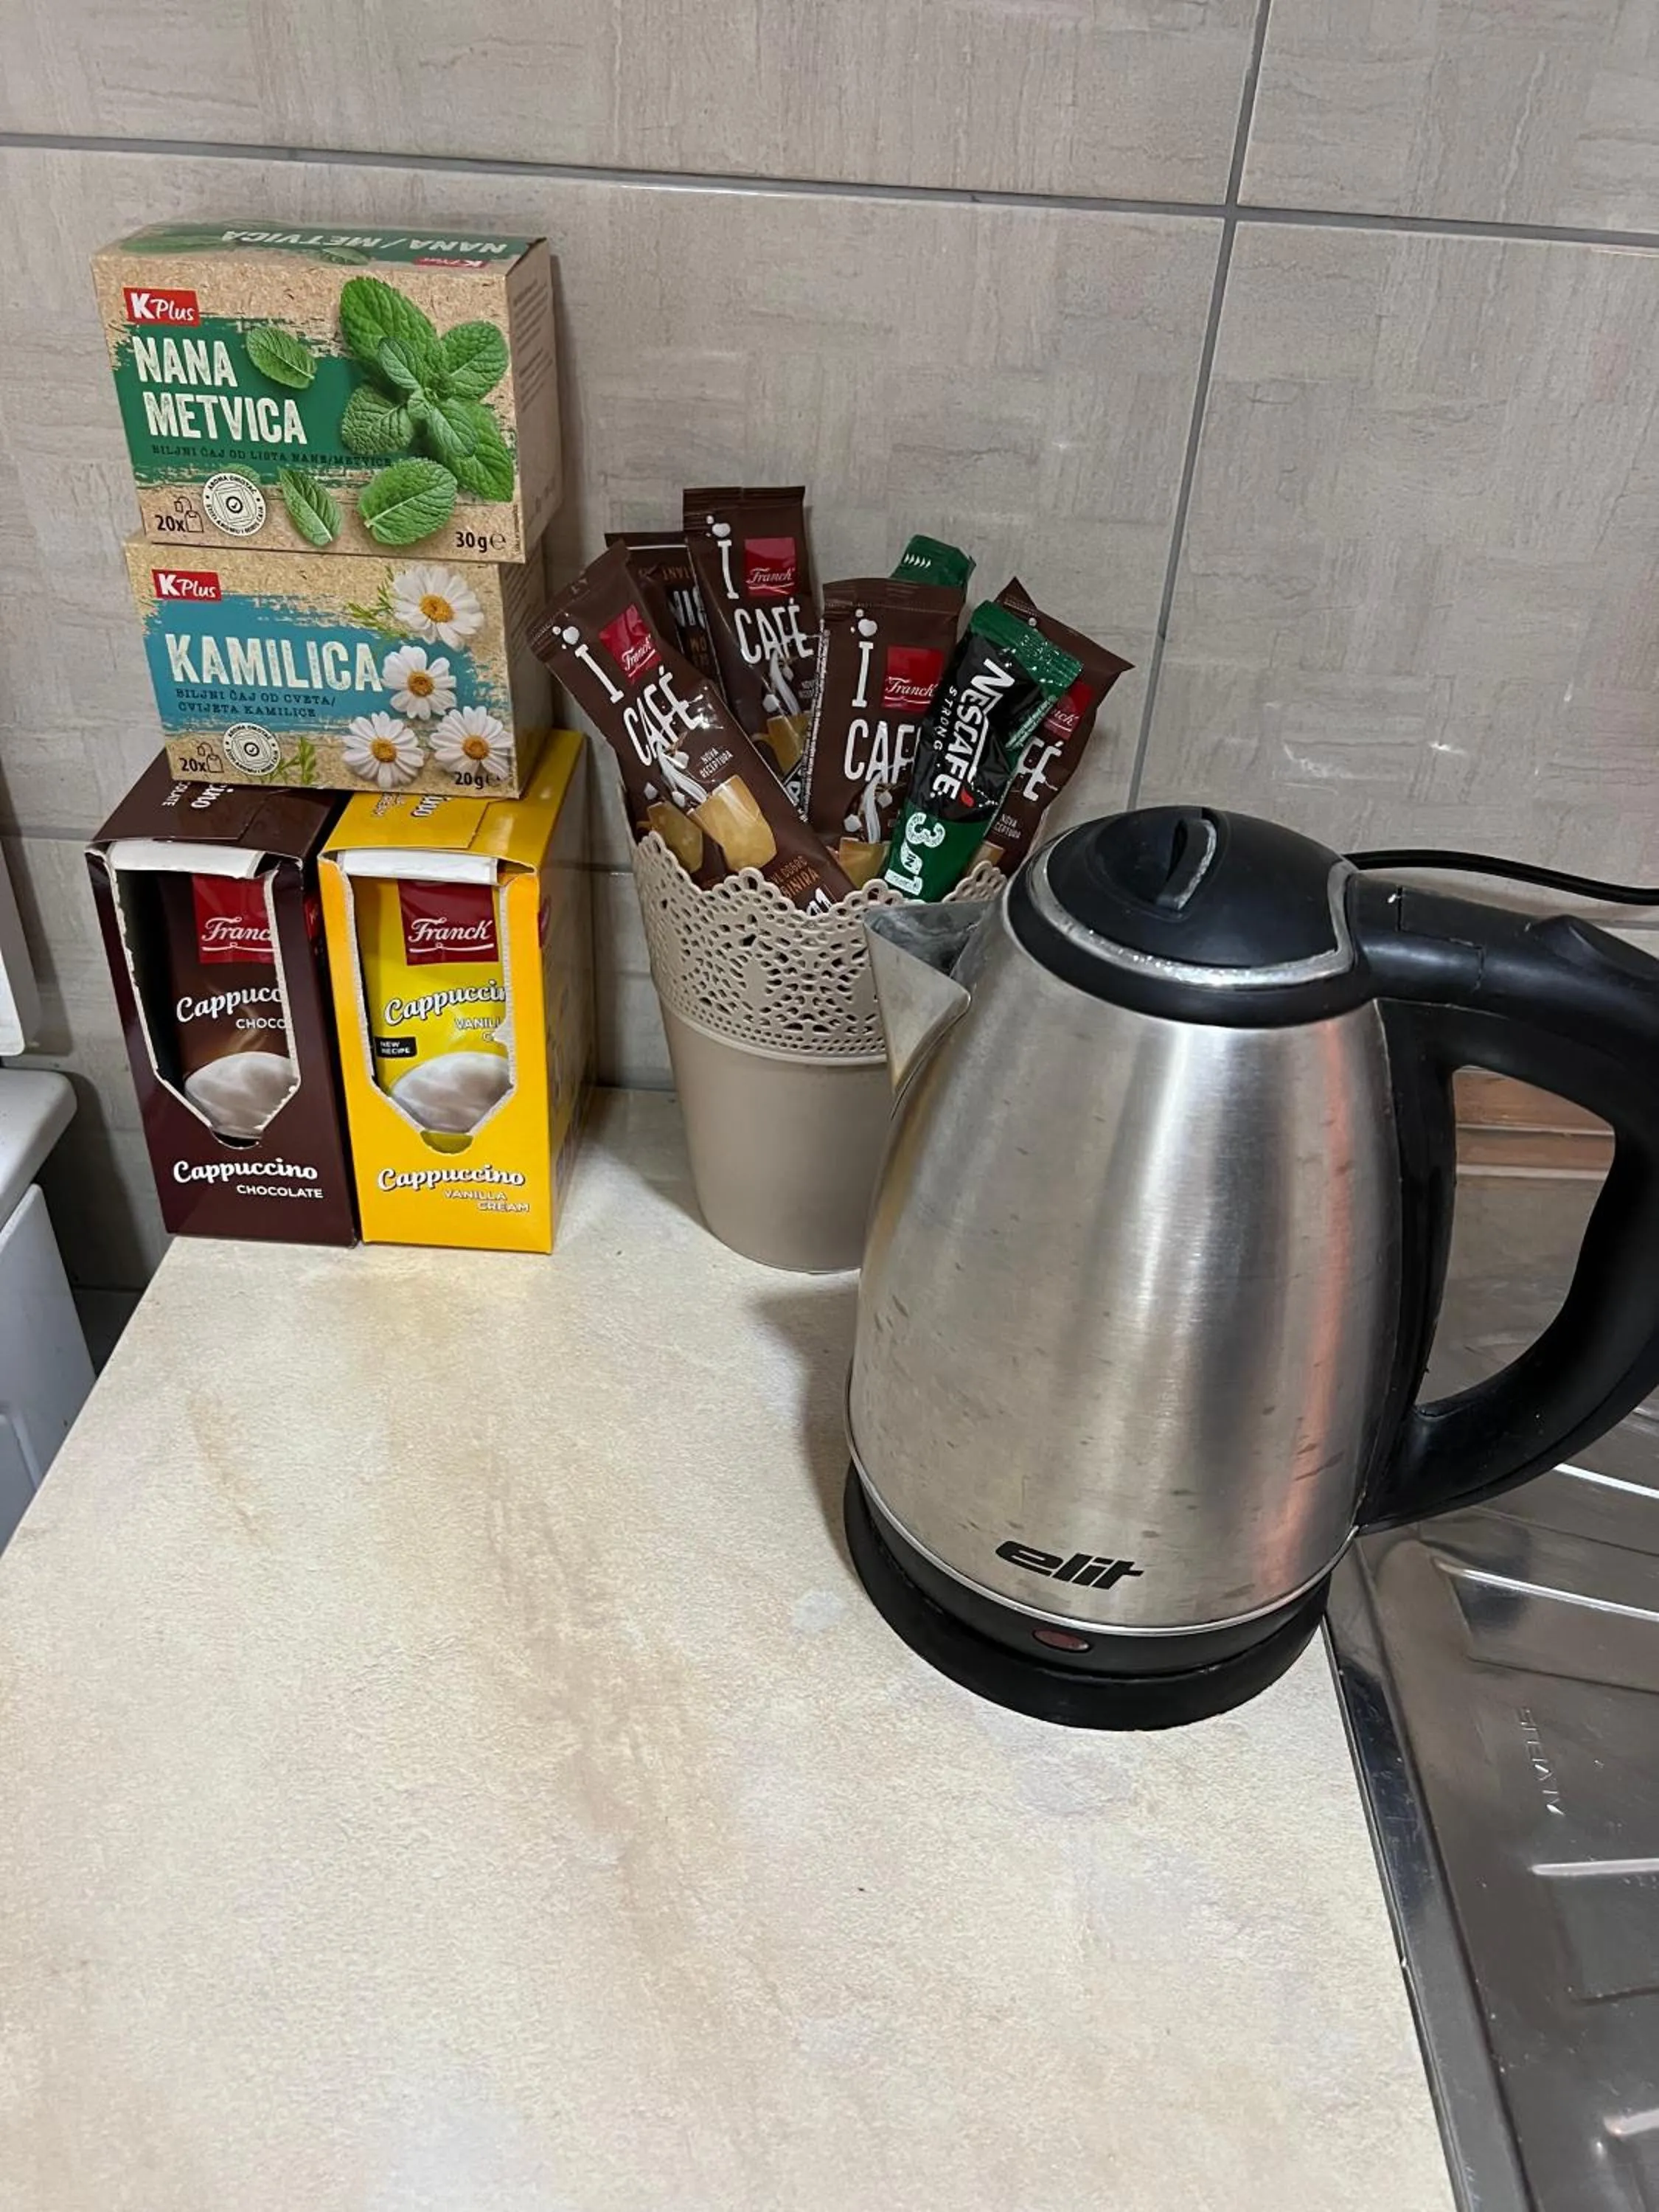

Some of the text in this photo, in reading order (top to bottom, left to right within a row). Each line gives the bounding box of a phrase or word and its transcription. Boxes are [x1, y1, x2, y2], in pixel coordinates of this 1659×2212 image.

[132, 335, 237, 386] NANA
[143, 392, 307, 444] METVICA
[229, 451, 246, 459] OD
[155, 514, 185, 532] 20x
[746, 563, 795, 585] Franck
[165, 633, 383, 692] KAMILICA
[622, 633, 653, 672] Franck
[176, 688, 225, 700] BILJNI
[229, 689, 257, 701] ČAJ
[260, 693, 279, 702] OD
[884, 674, 939, 698] Franck
[178, 702, 316, 717] CVIJETA KAMILICE
[933, 684, 958, 752] STRONG
[179, 757, 207, 772] 20x
[844, 719, 921, 785] CAF
[201, 917, 273, 942] Franc
[408, 917, 493, 942] Franck
[176, 987, 282, 1023] Cappucc
[236, 1018, 287, 1029] CHOCO
[173, 1157, 318, 1184] Cappuccino
[378, 1164, 526, 1192] Cappuccino
[237, 1184, 324, 1199] CHOCOLATE
[444, 1189, 508, 1201] VANILLA
[477, 1200, 530, 1213] CREAM
[996, 1540, 1144, 1590] elit
